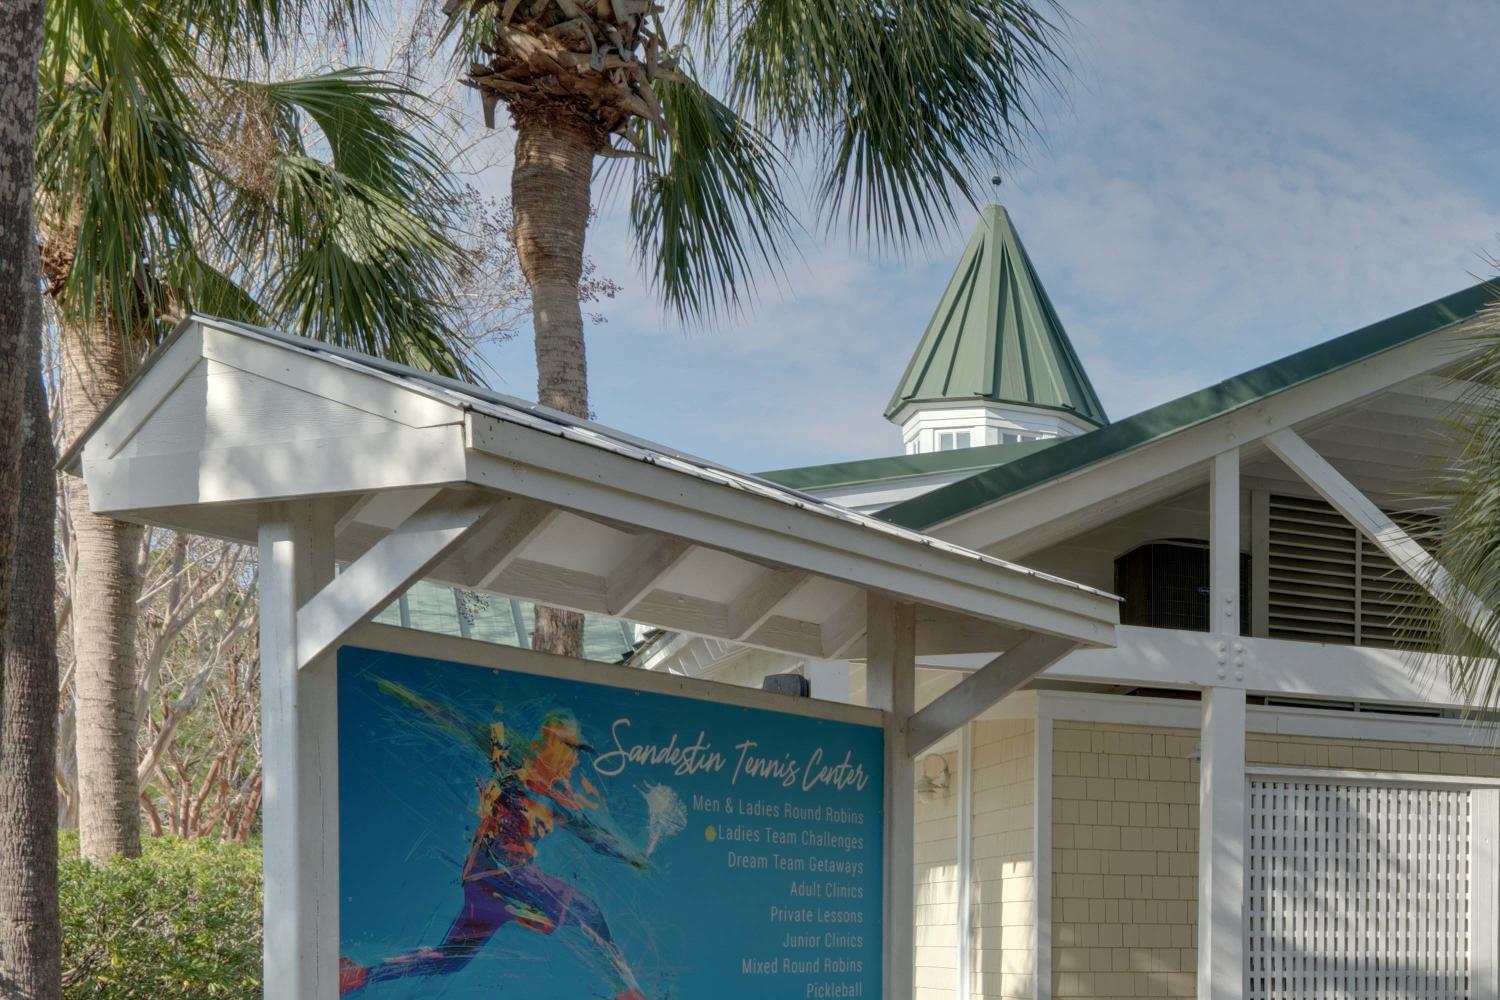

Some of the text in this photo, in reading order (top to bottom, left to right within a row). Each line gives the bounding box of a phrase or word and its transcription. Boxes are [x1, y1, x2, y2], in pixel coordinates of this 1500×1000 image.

[593, 718, 869, 792] Sandestin Tennis Center
[693, 794, 864, 825] Men & Ladies Round Robins
[718, 824, 864, 852] Ladies Team Challenges
[728, 851, 864, 878] Dream Team Getaways
[790, 881, 864, 899] Adult Clinics
[770, 906, 864, 924] Private Lessons
[783, 932, 864, 948] Junior Clinics
[742, 956, 863, 974] Mixed Round Robins
[806, 982, 863, 999] Pickleball
